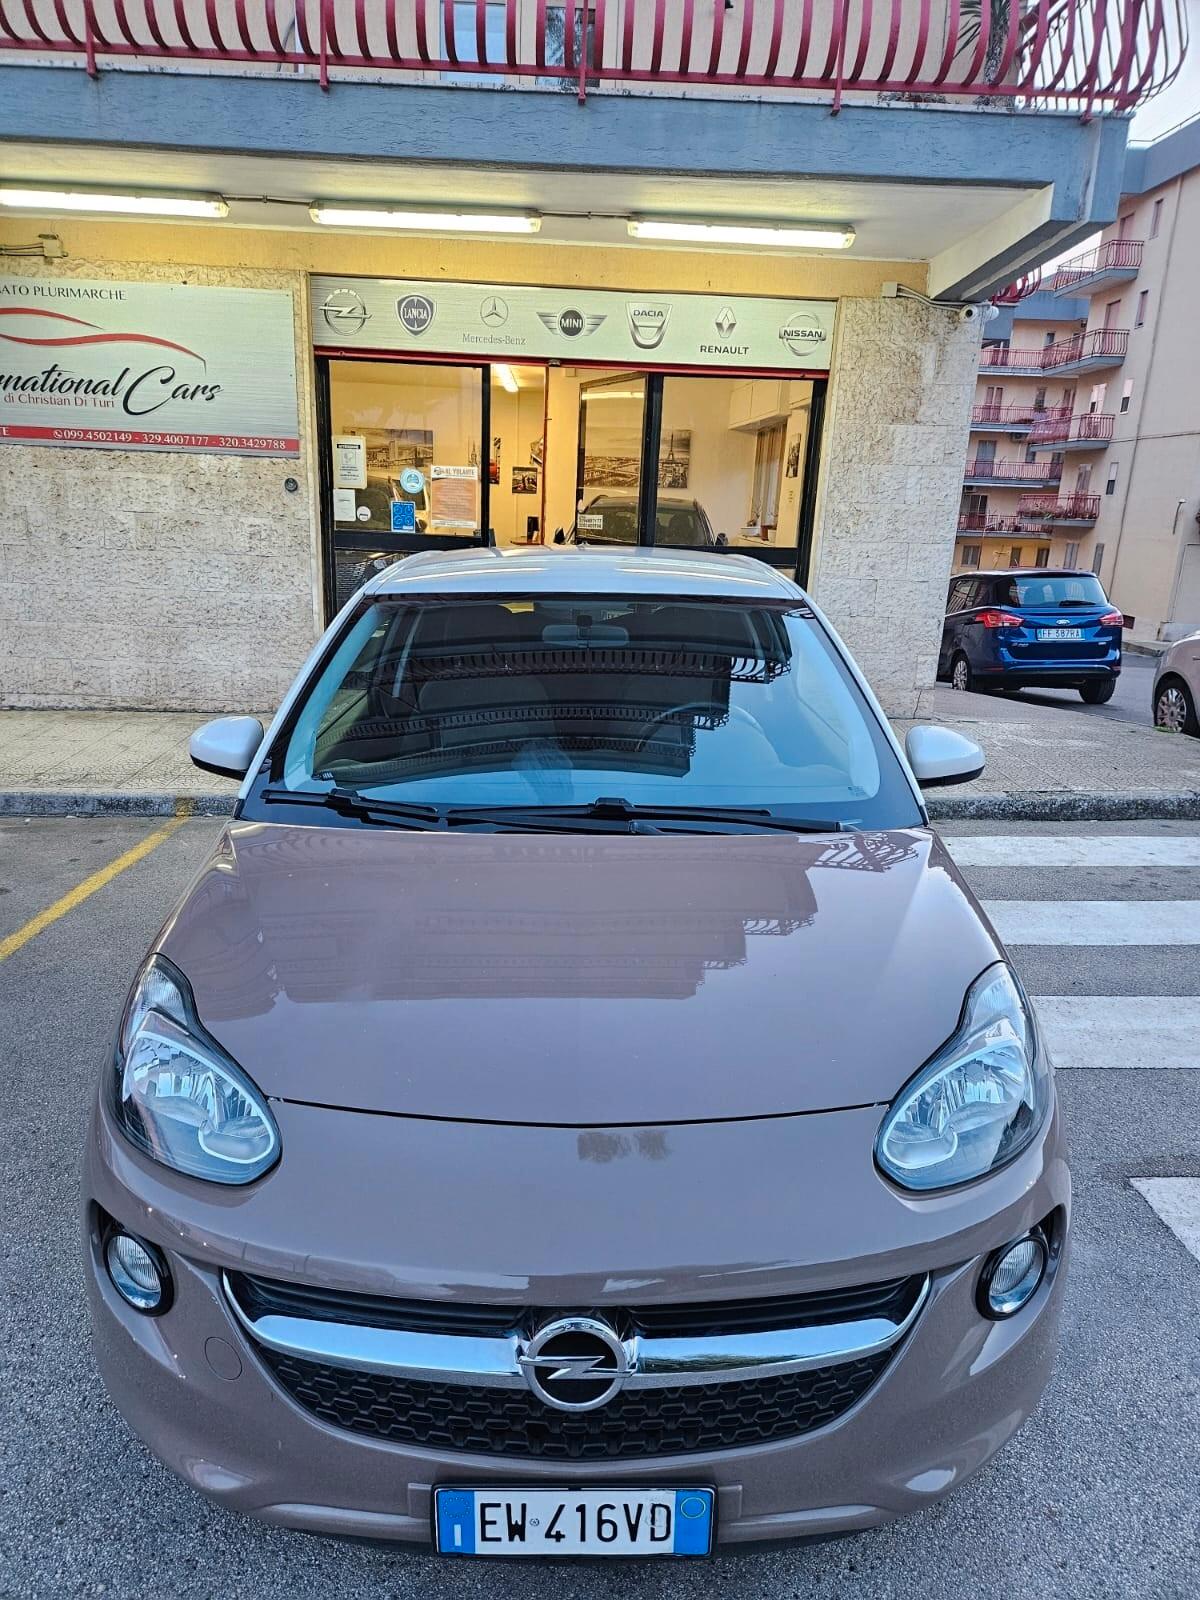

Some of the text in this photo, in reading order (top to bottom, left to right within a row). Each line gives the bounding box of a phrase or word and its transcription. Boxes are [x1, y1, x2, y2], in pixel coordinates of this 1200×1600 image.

[0, 284, 127, 301] ATO PLURIMARCHE
[404, 308, 428, 320] LANCIA
[633, 309, 664, 318] DACIA
[560, 318, 583, 330] MINI
[462, 333, 526, 346] Mercedes-Benz
[783, 329, 823, 338] NISSAN
[700, 345, 749, 355] RENAULT
[122, 365, 224, 416] Cars
[4, 392, 115, 408] di Christian Di Turi
[63, 429, 132, 443] 099.4502149
[142, 433, 209, 447] 329.4007177
[218, 436, 286, 450] 320.3429788
[480, 1502, 672, 1543] EW 416VD
